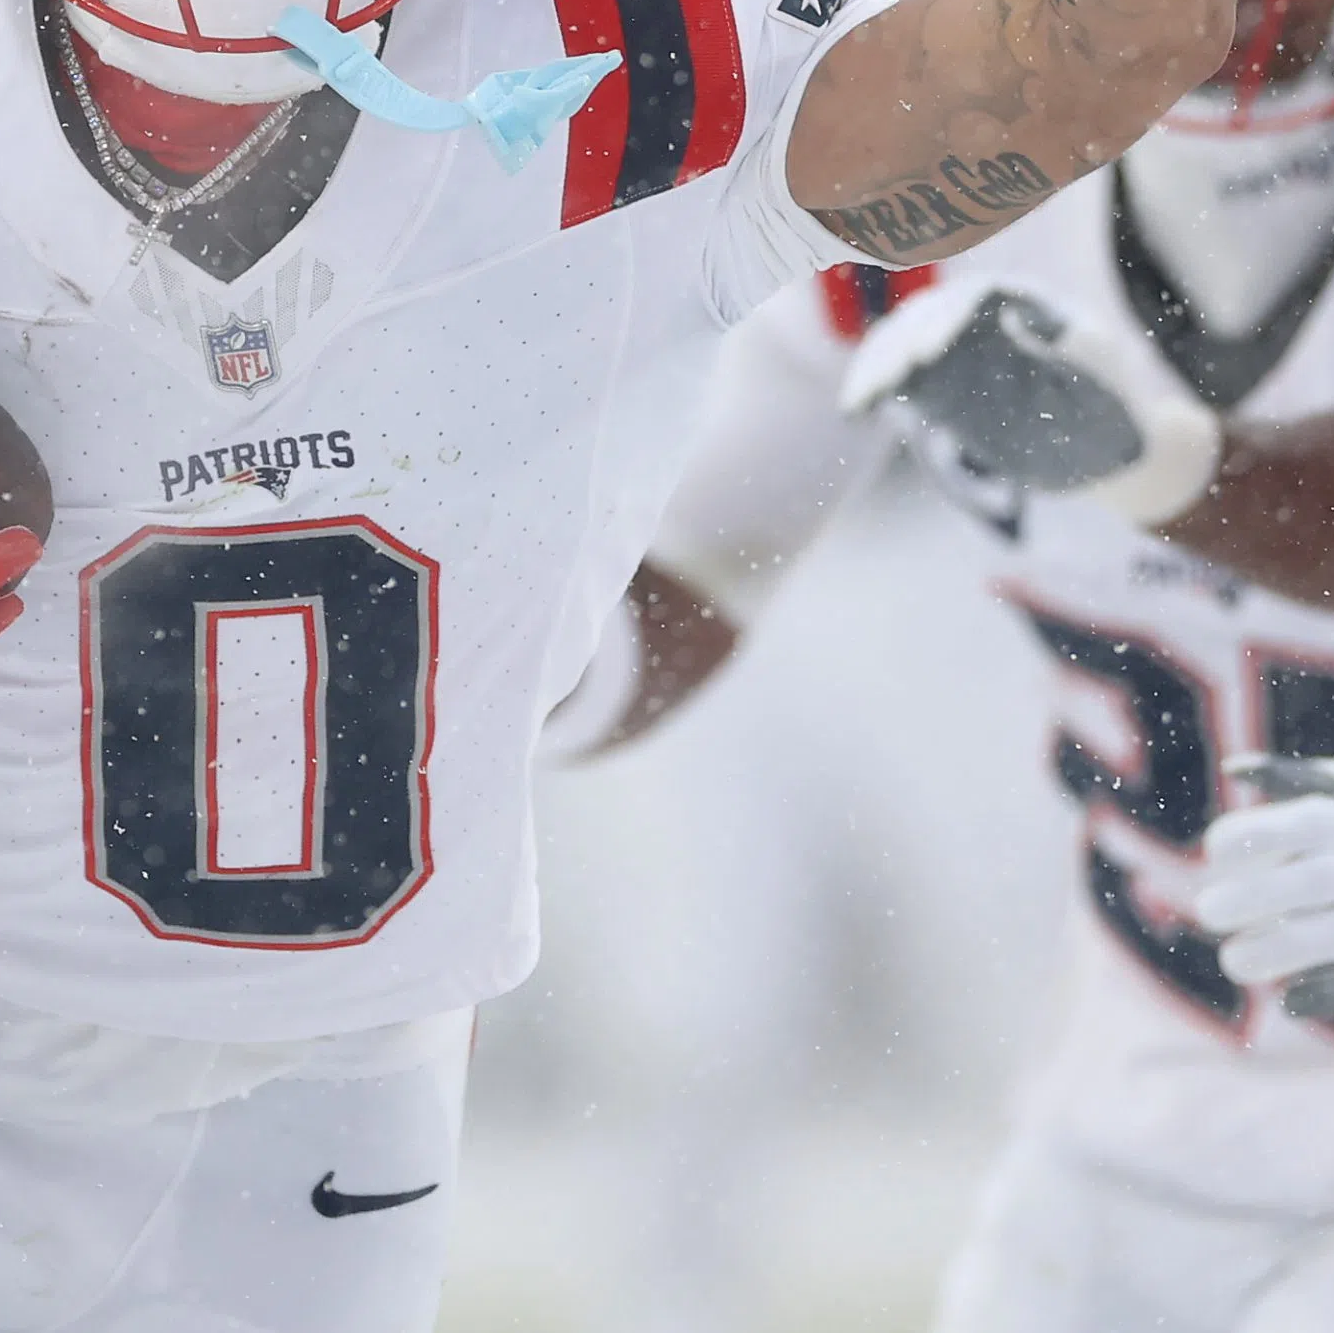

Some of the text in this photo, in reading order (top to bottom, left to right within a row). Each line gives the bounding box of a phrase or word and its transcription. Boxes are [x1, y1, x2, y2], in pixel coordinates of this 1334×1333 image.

[217, 351, 270, 383] NFL
[158, 429, 355, 503] PATRIOTS
[78, 513, 440, 951] 0
